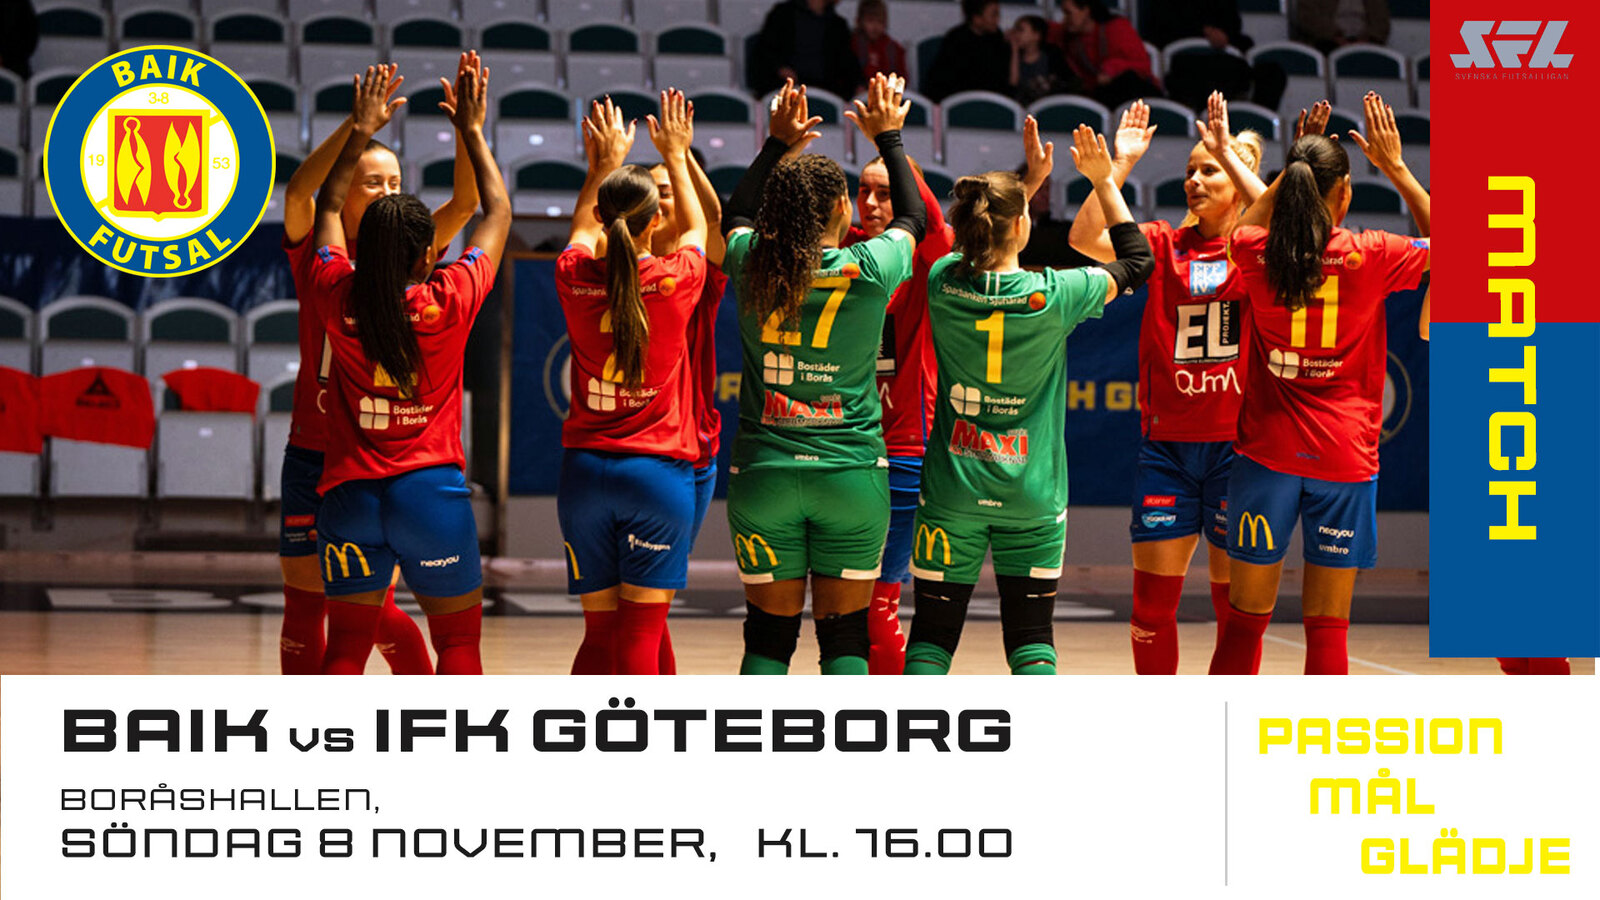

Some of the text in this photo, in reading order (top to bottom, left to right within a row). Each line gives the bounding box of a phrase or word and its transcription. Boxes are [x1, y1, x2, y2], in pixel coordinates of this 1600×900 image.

[975, 310, 1005, 384] 1
[797, 361, 840, 373] Bostäder
[1303, 358, 1344, 368] Bostäder
[806, 373, 834, 383] Borås
[763, 390, 844, 419] MAXI
[984, 395, 1027, 406] Bostäder
[992, 405, 1019, 416] Borås
[950, 418, 1029, 456] MAXI
[978, 499, 1003, 507] umbro
[1319, 544, 1350, 555] umbro
